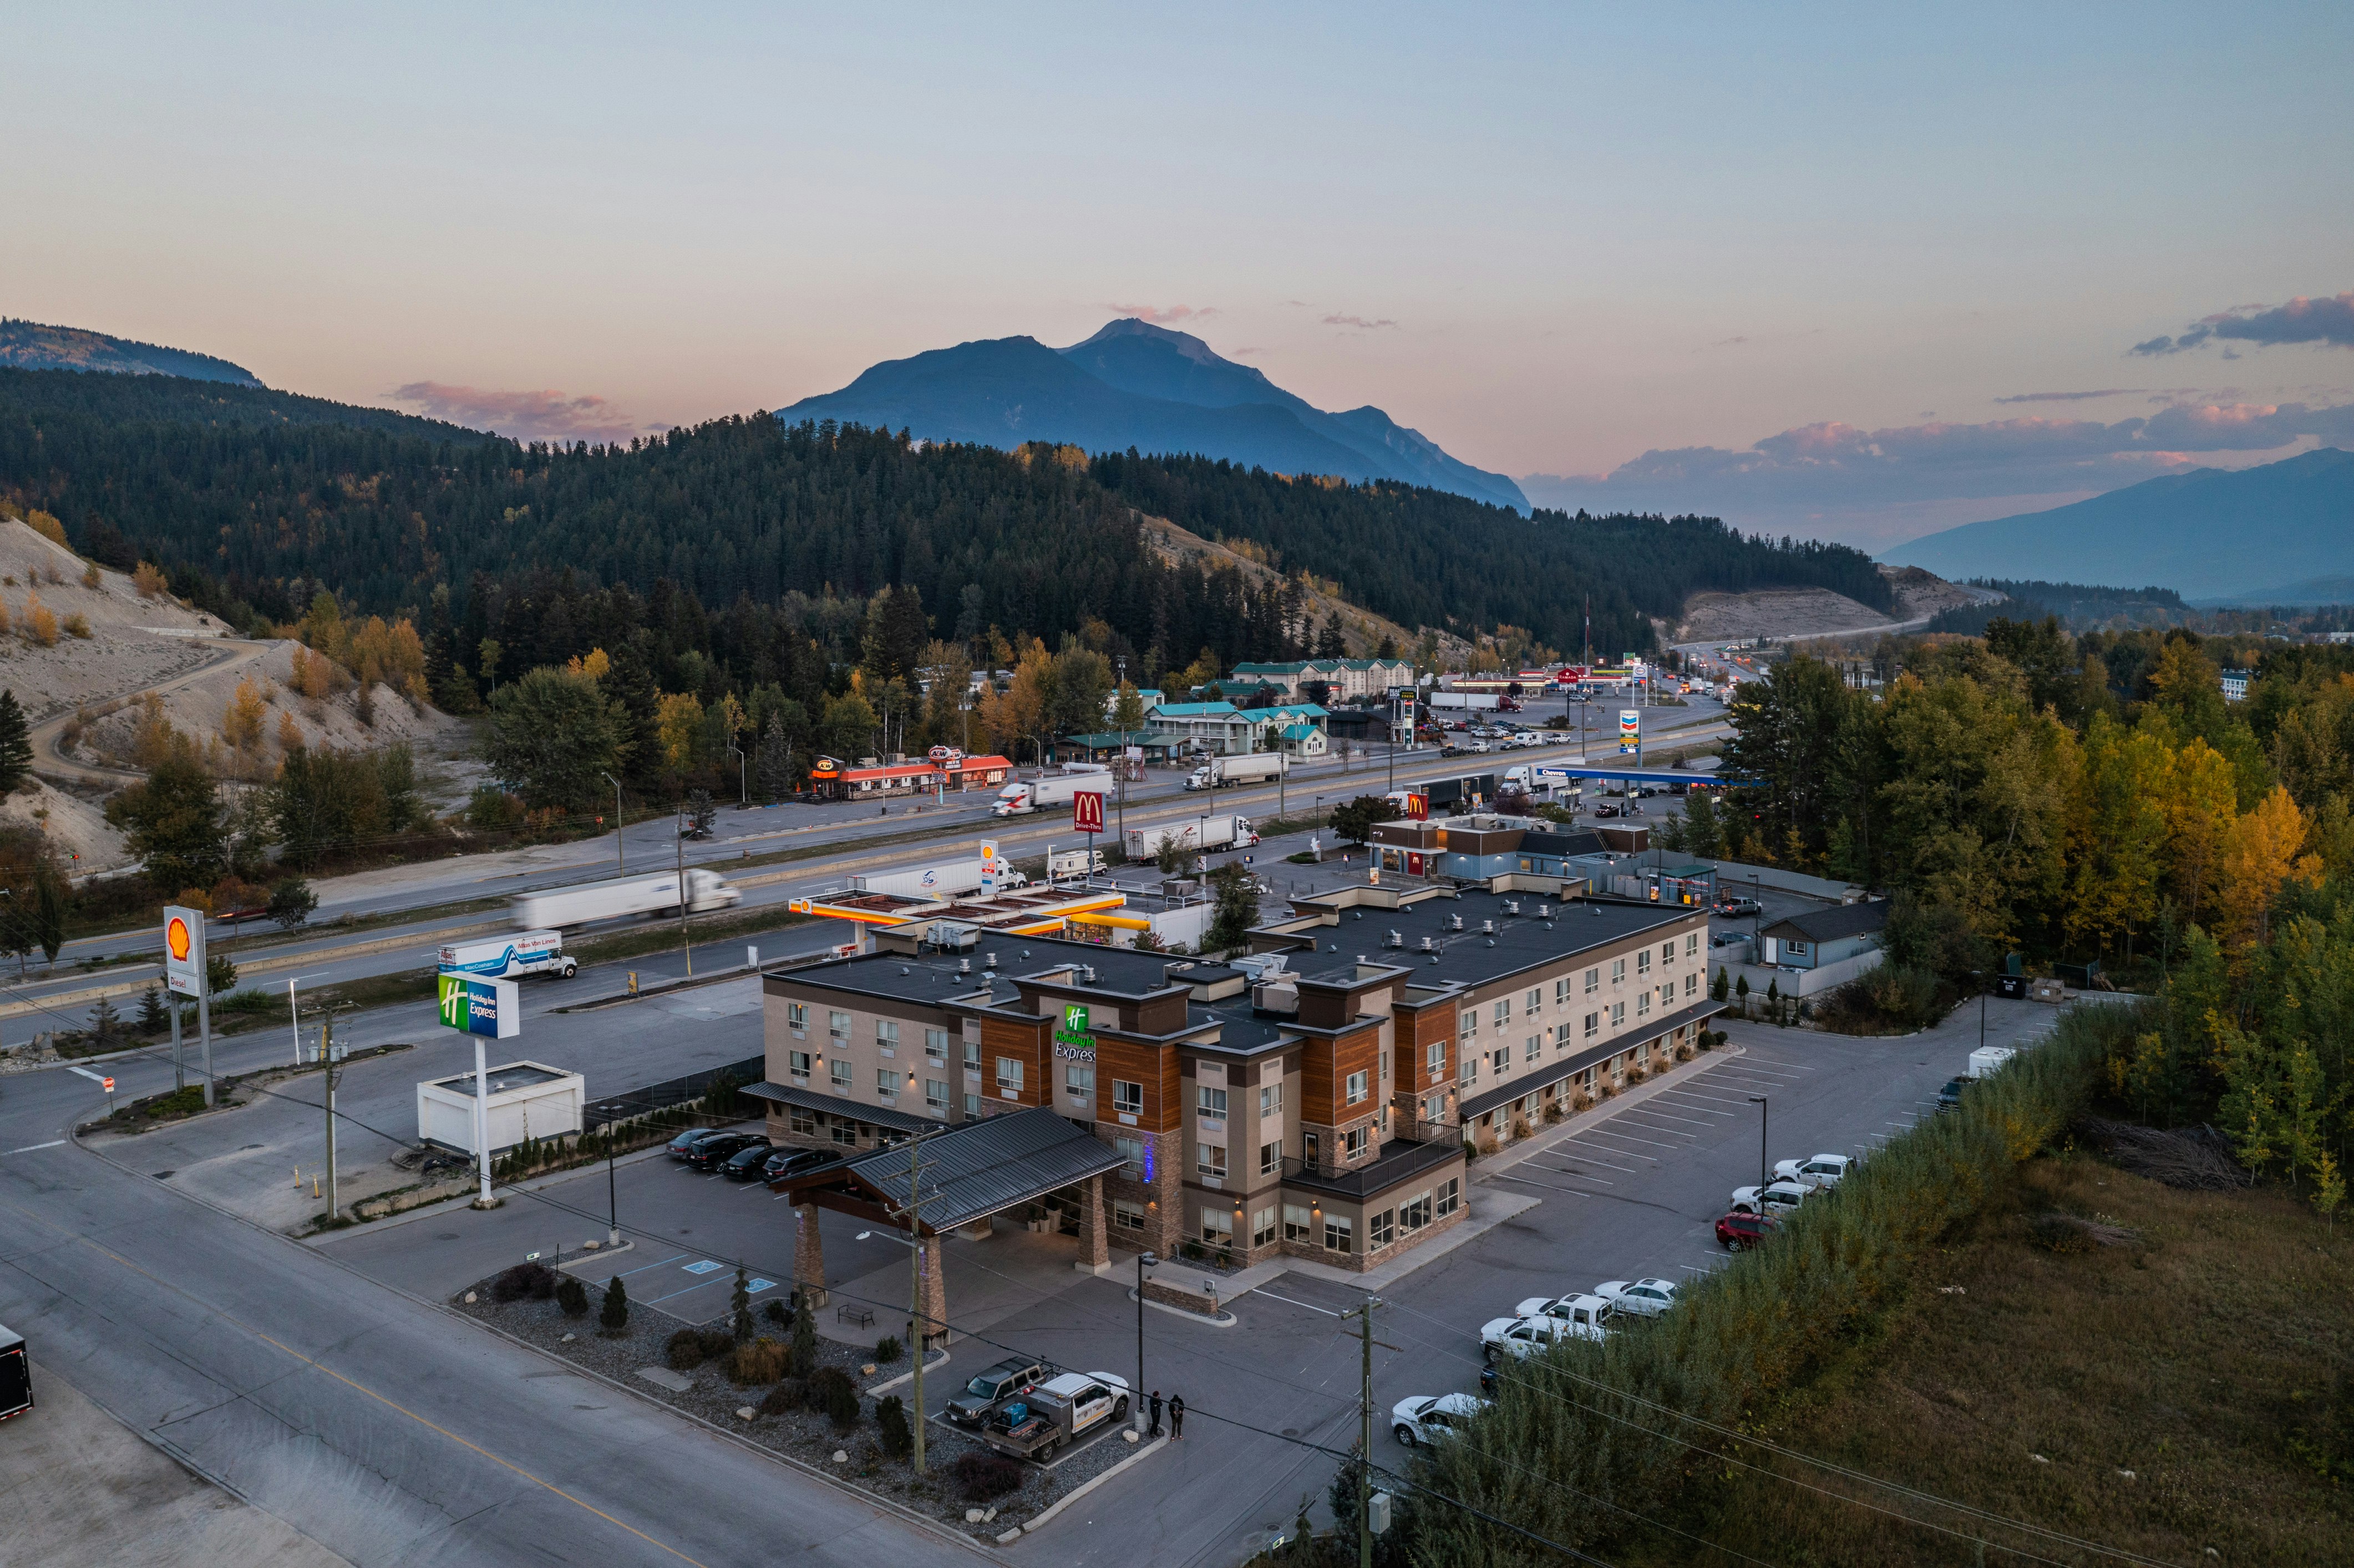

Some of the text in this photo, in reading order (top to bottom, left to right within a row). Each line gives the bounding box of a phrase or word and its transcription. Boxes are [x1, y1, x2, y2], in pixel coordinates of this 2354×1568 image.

[465, 961, 494, 971] MacCosham
[171, 976, 186, 988] Diesel
[469, 992, 496, 1006] Holiday Inn
[470, 1002, 496, 1019] Express
[1056, 1031, 1096, 1048] Holiday In
